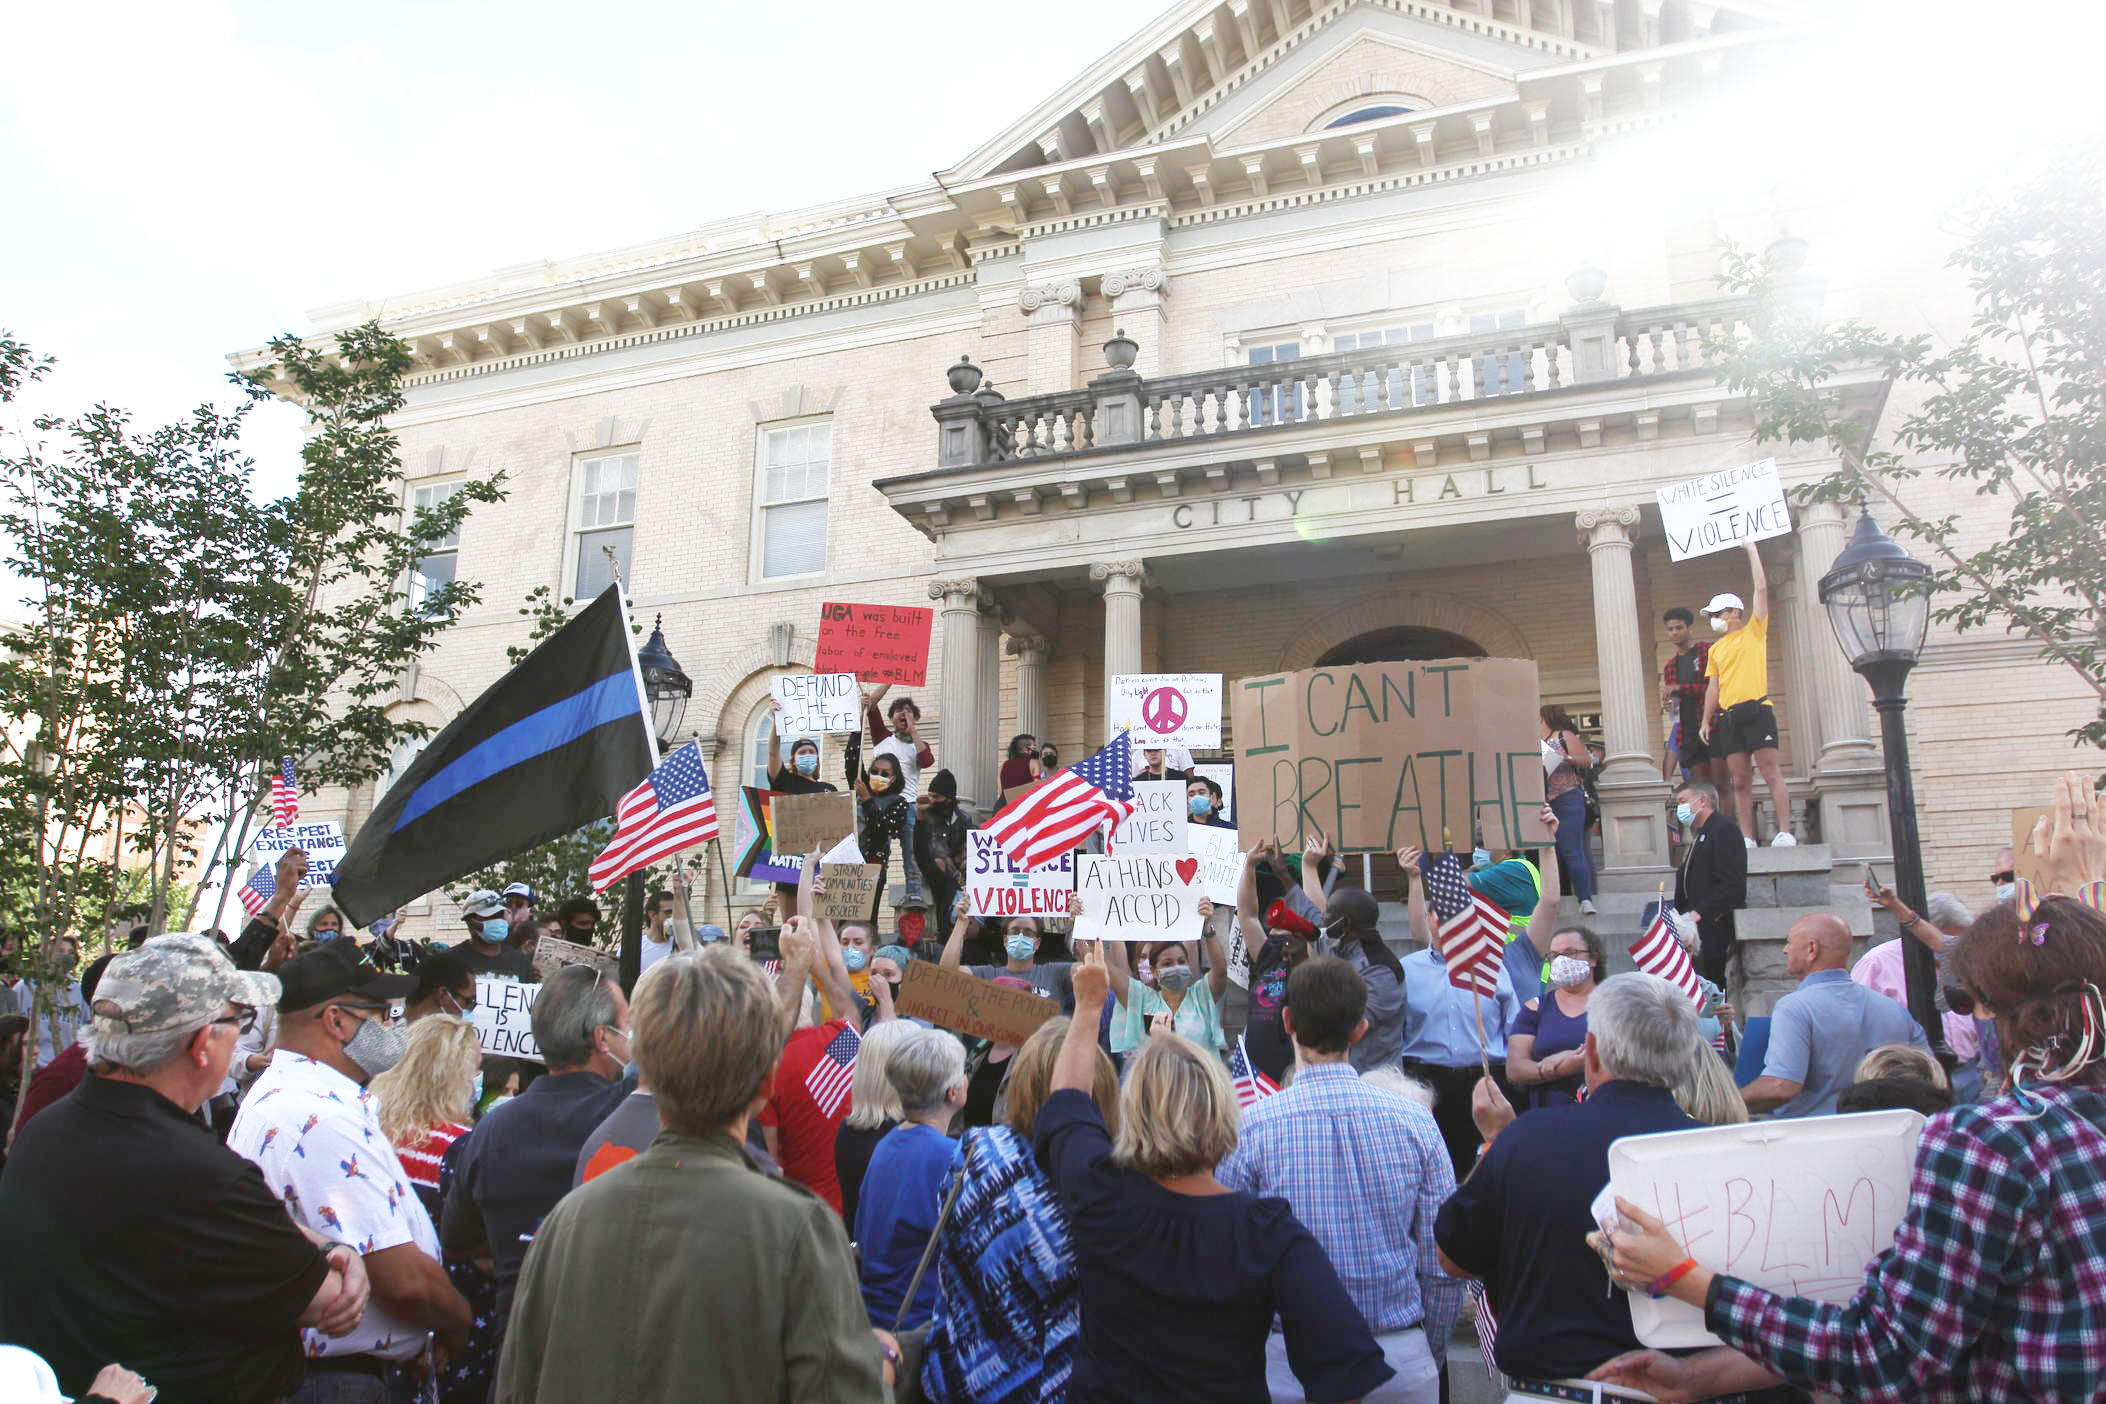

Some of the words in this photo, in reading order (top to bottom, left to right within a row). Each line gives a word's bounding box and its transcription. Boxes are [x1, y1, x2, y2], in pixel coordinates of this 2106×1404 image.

[1661, 478, 1709, 505] WHITE
[1710, 460, 1773, 492] SILENCE
[1172, 489, 1304, 529] CITY
[1391, 465, 1547, 504] HALL
[1667, 499, 1789, 554] VIOLENCE
[821, 602, 853, 622] UGA
[863, 612, 887, 623] was
[892, 608, 923, 625] built
[845, 624, 865, 638] the
[873, 625, 901, 640] free
[818, 645, 844, 656] labor
[853, 647, 865, 658] of
[782, 675, 853, 697] DEFUND
[792, 697, 830, 715] THE
[1244, 678, 1290, 757] I
[1307, 664, 1469, 737] CAN'T
[784, 712, 854, 733] POLICE
[1136, 791, 1173, 812] ACK
[1273, 750, 1557, 853] BREATHE
[263, 824, 331, 839] RESPECT
[1114, 820, 1174, 845] LIVES
[256, 836, 345, 851] EXISTANCE
[768, 854, 805, 870] MATTE
[832, 863, 864, 877] STRONG
[1085, 857, 1174, 890] ATHENS
[824, 878, 873, 892] OMMUNITIES
[841, 892, 865, 905] POLICE
[973, 887, 1073, 916] VIOLENCE
[824, 904, 861, 918] OBSOLETE
[1104, 893, 1181, 930] ACCPD
[909, 961, 973, 998] DEFUND
[981, 984, 1007, 1007] THE
[495, 1009, 509, 1025] IS
[907, 1000, 949, 1024] INVEST
[955, 1016, 971, 1033] IN
[1653, 1176, 1876, 1272] #BLM
